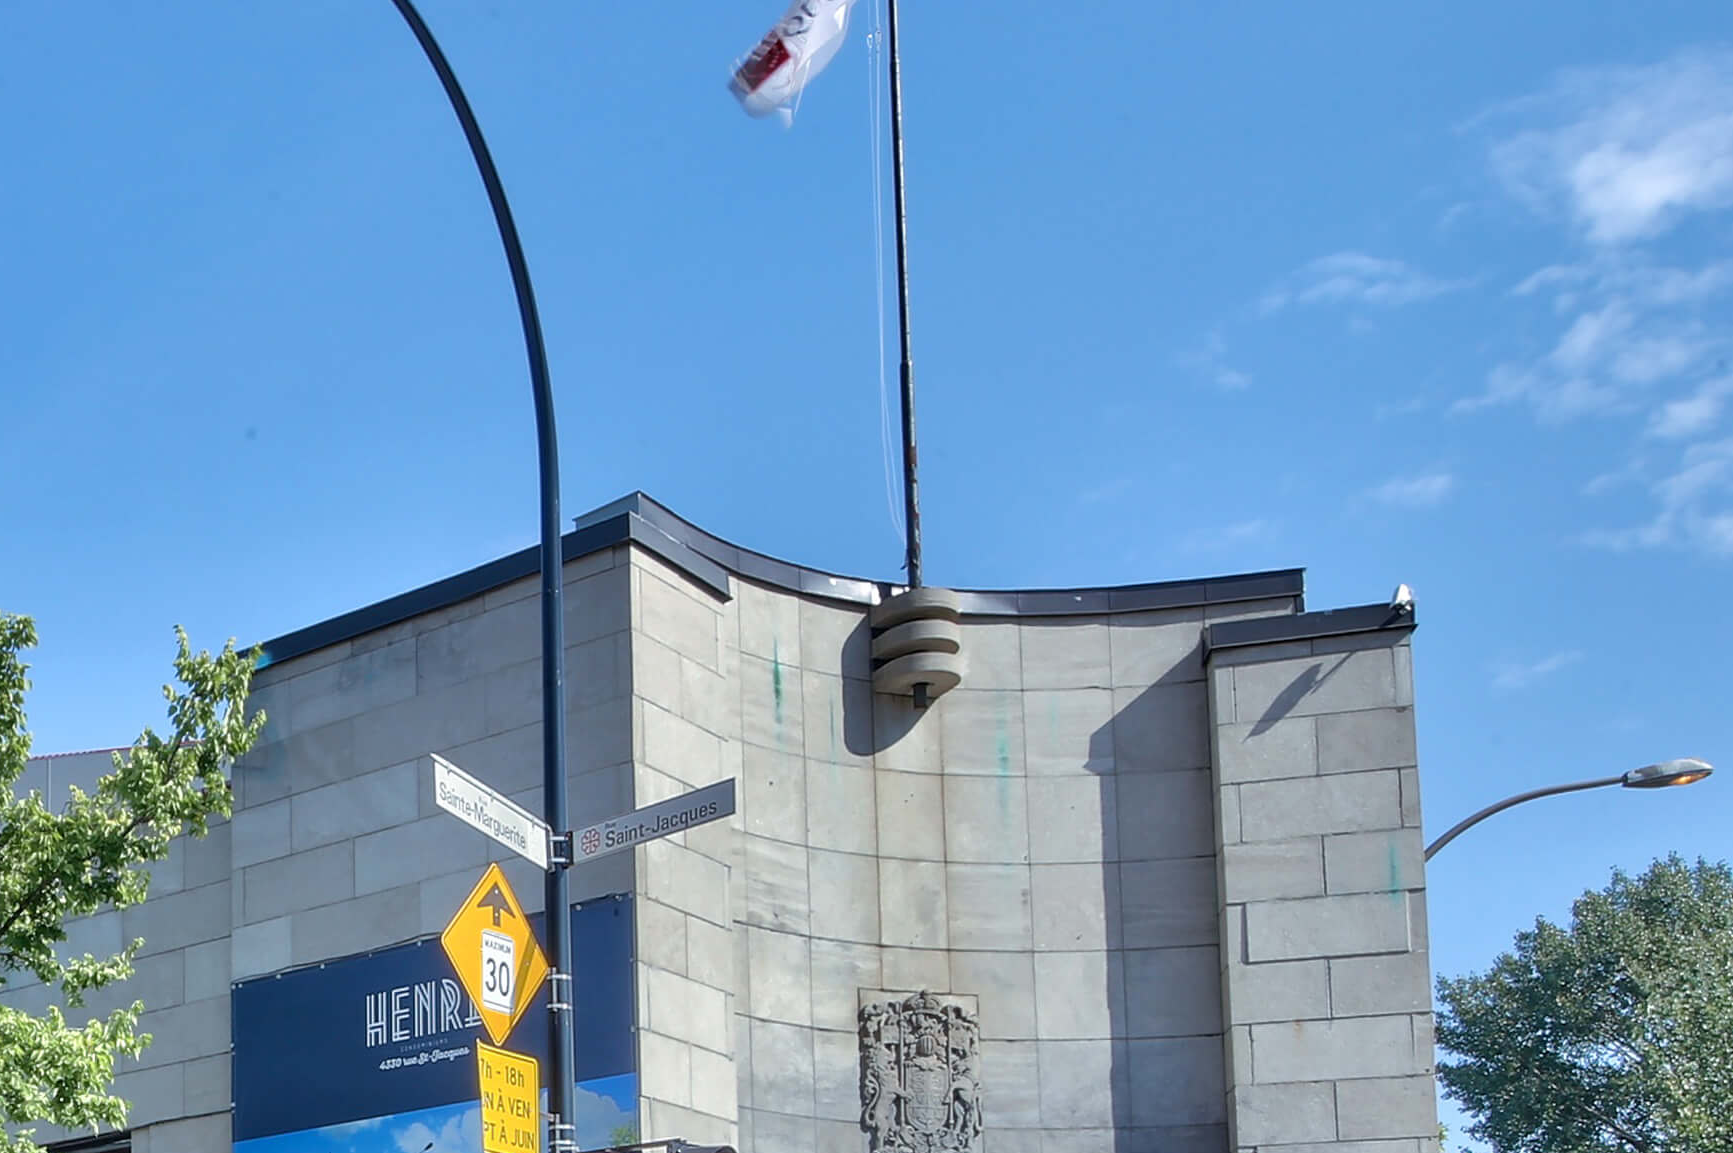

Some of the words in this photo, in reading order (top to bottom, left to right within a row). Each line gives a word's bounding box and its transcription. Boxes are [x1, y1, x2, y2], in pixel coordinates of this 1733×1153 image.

[439, 781, 527, 850] Sainte-Marguerite
[604, 801, 717, 849] Saint-Jacques
[485, 957, 510, 997] 30
[505, 1065, 525, 1089] 18h
[497, 1088, 506, 1113] À
[508, 1097, 531, 1120] VEN
[499, 1119, 508, 1145] À
[511, 1128, 535, 1151] JUIN
